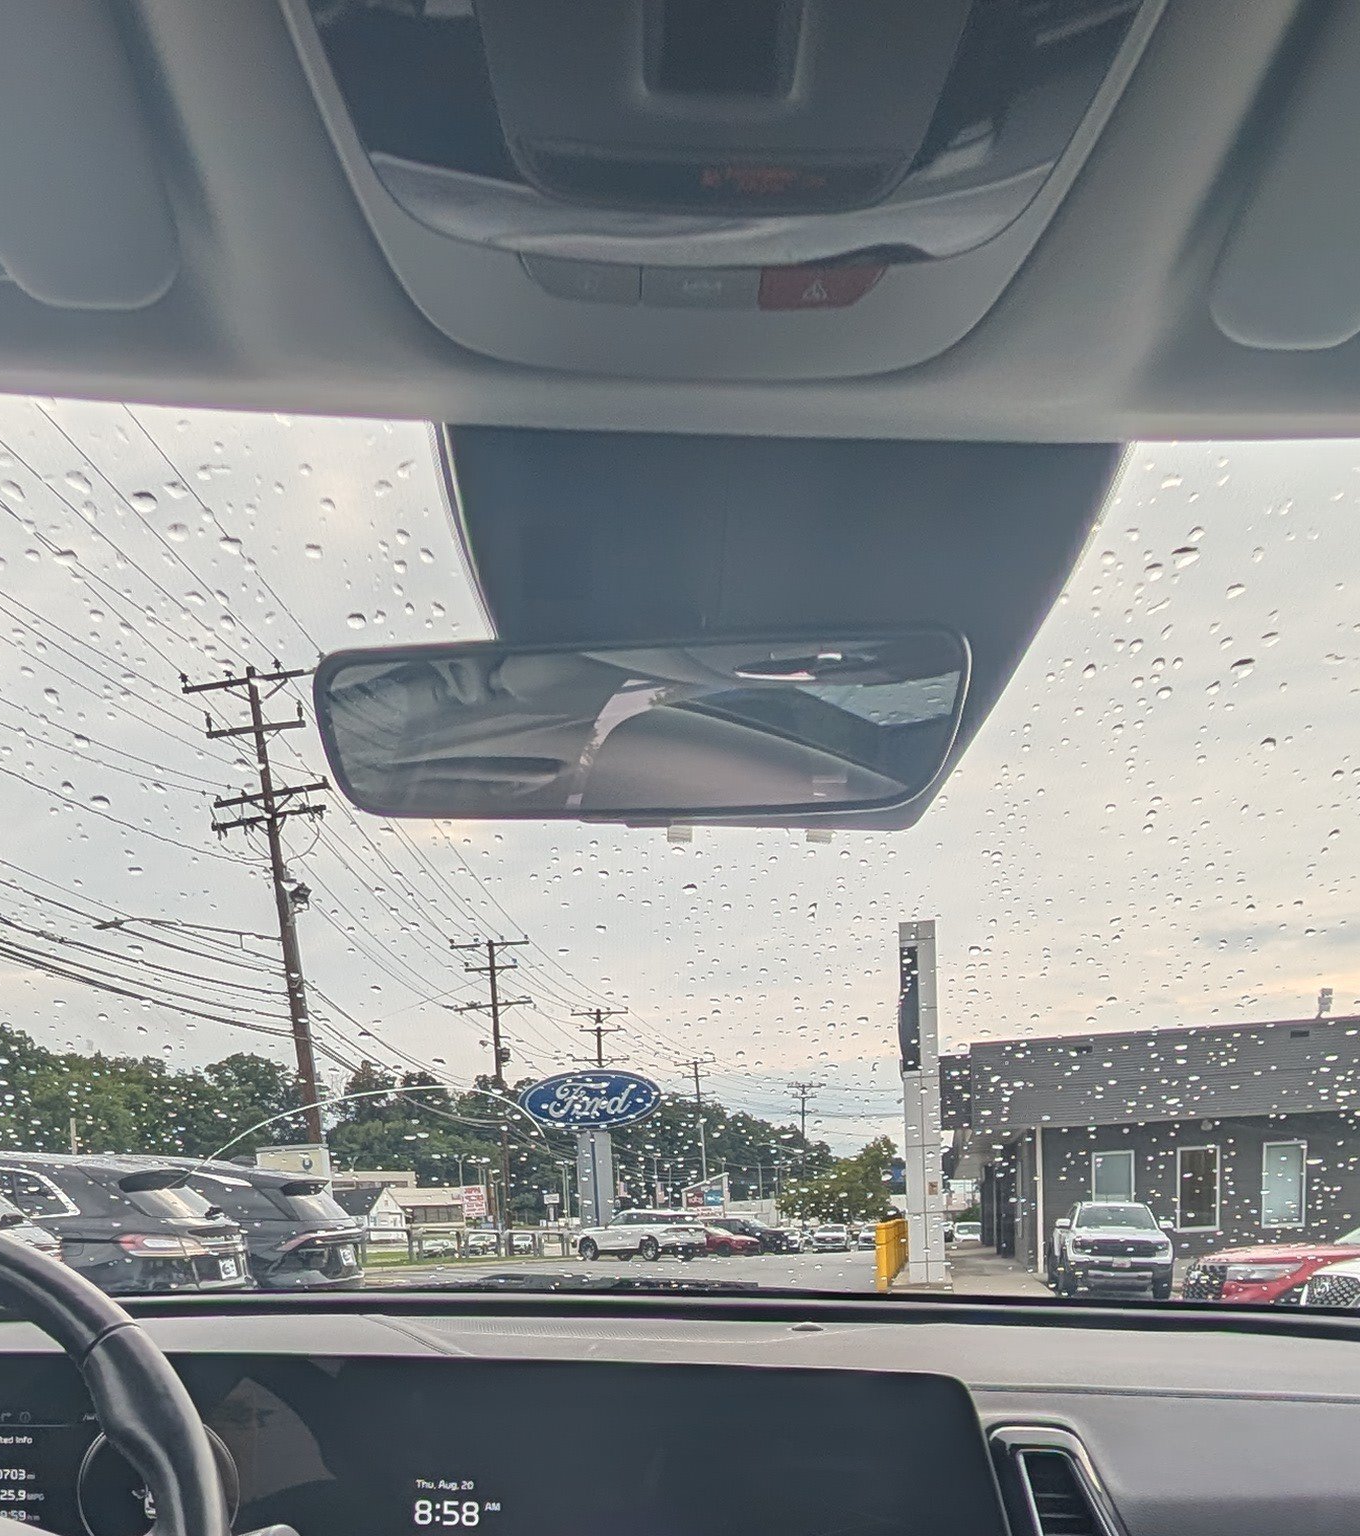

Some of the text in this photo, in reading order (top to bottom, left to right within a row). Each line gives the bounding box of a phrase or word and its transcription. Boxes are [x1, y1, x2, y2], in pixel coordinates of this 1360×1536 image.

[549, 1082, 637, 1118] Ford
[15, 1435, 33, 1445] Info
[461, 1480, 475, 1490] 20
[0, 1489, 26, 1501] 25.9
[414, 1500, 501, 1527] 8:58 AM
